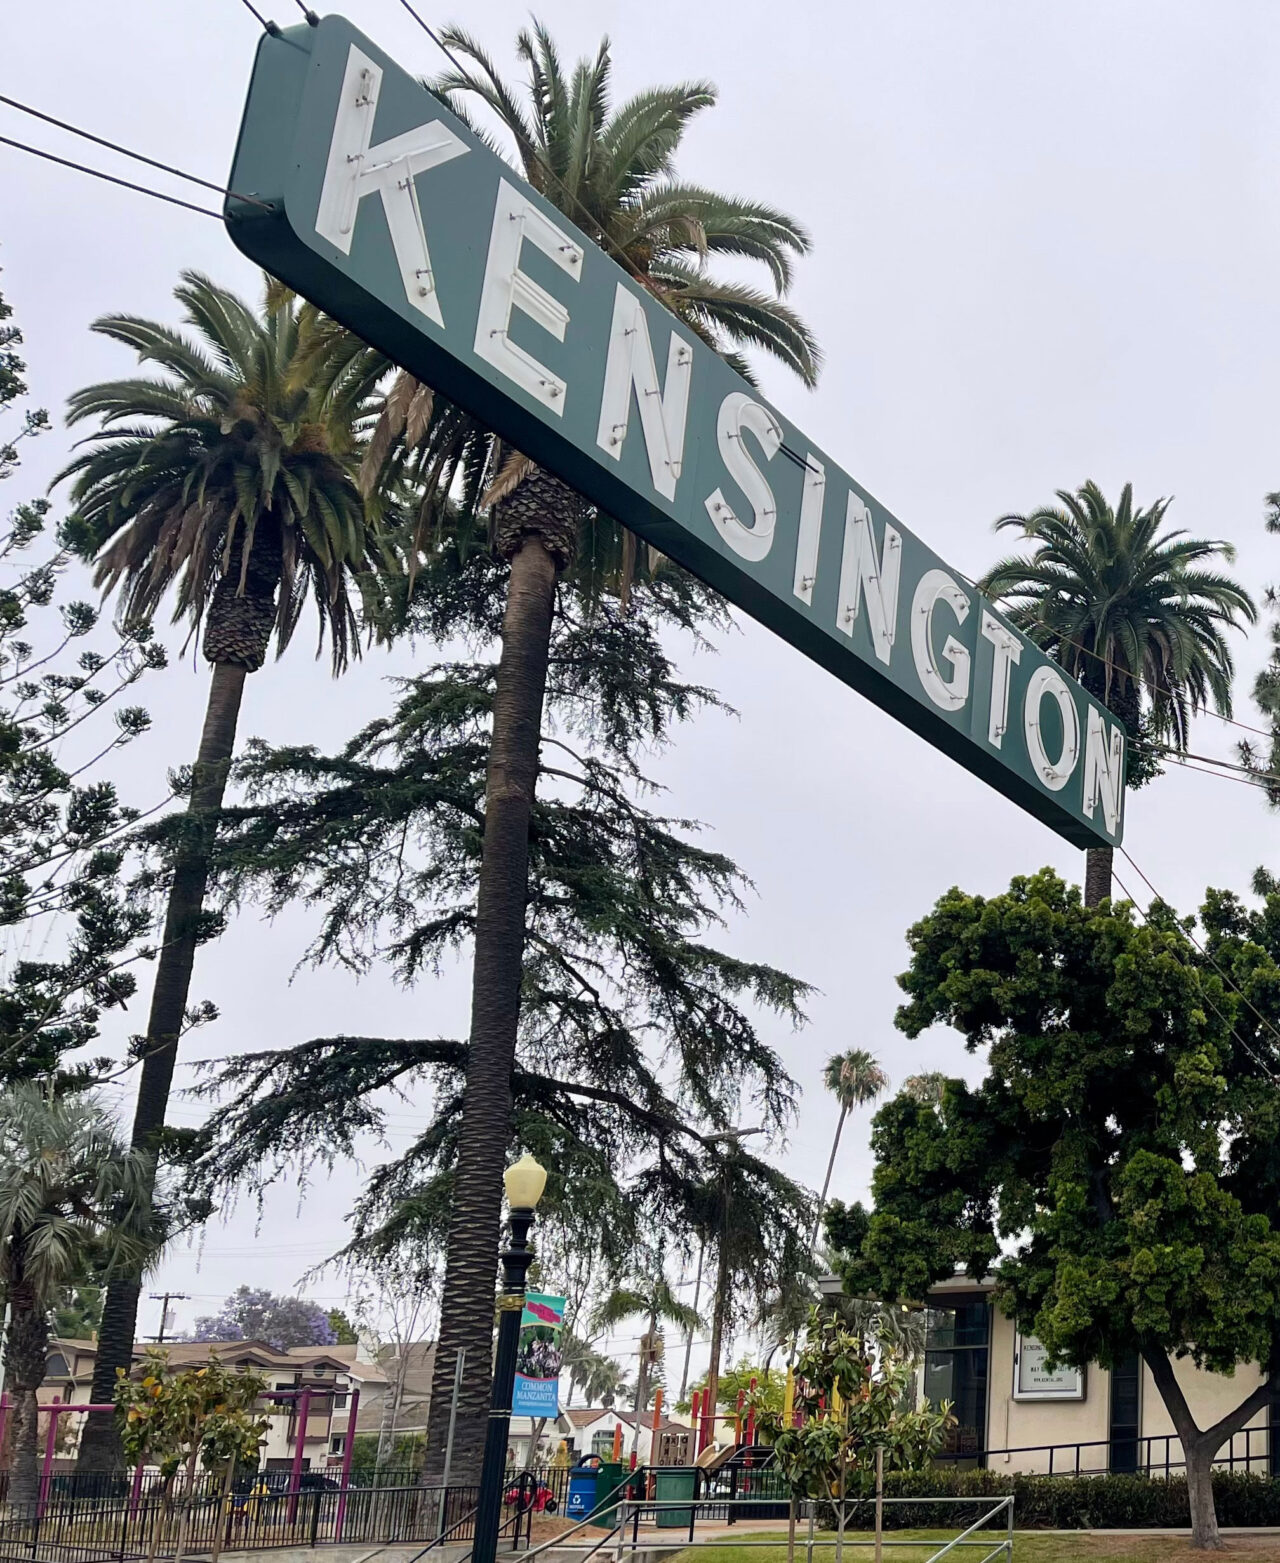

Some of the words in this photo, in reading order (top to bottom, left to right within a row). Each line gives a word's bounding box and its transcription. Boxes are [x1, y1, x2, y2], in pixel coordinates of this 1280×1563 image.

[315, 43, 1124, 837] KENSINGTON
[521, 1381, 553, 1392] COMMON
[516, 1391, 556, 1401] MANZANITA
